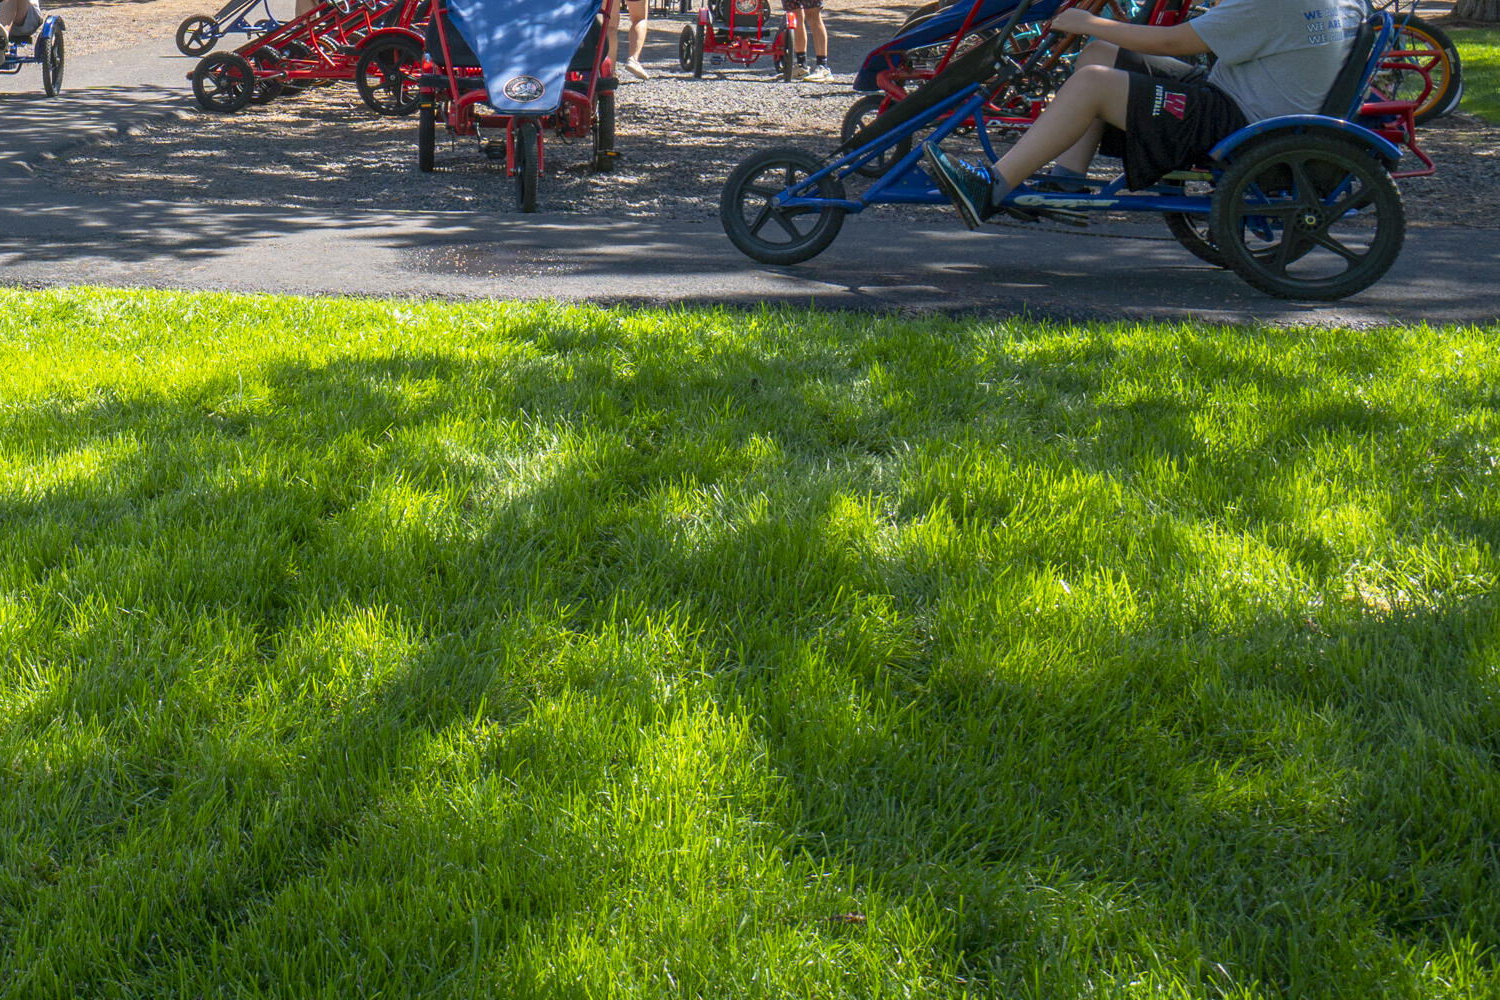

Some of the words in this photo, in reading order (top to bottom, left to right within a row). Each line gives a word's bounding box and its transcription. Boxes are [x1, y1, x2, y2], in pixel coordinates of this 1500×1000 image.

[1304, 10, 1323, 20] WE
[1306, 22, 1325, 33] WE
[1308, 34, 1327, 45] WE
